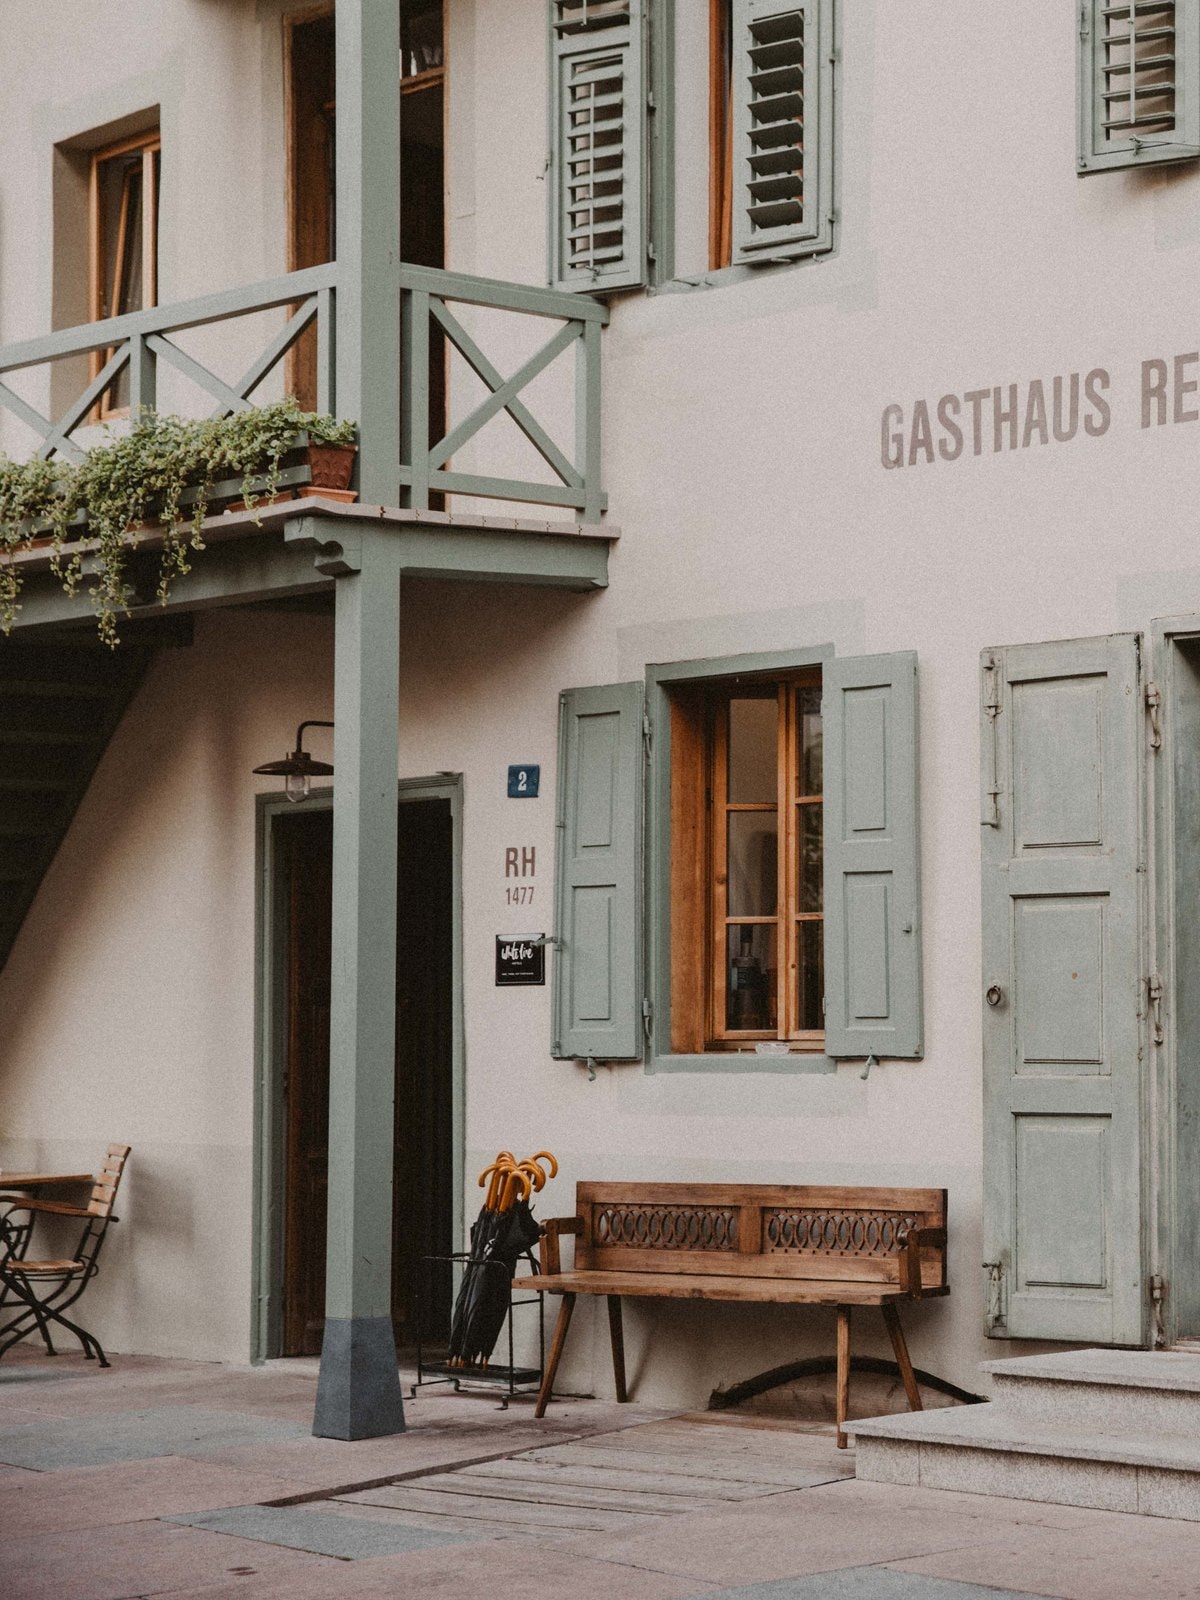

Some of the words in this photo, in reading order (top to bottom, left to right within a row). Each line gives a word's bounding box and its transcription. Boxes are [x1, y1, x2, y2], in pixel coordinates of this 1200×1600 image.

[880, 367, 1111, 471] GASTHAUS
[517, 771, 527, 791] 2
[504, 846, 536, 878] RH
[505, 885, 535, 906] 1477
